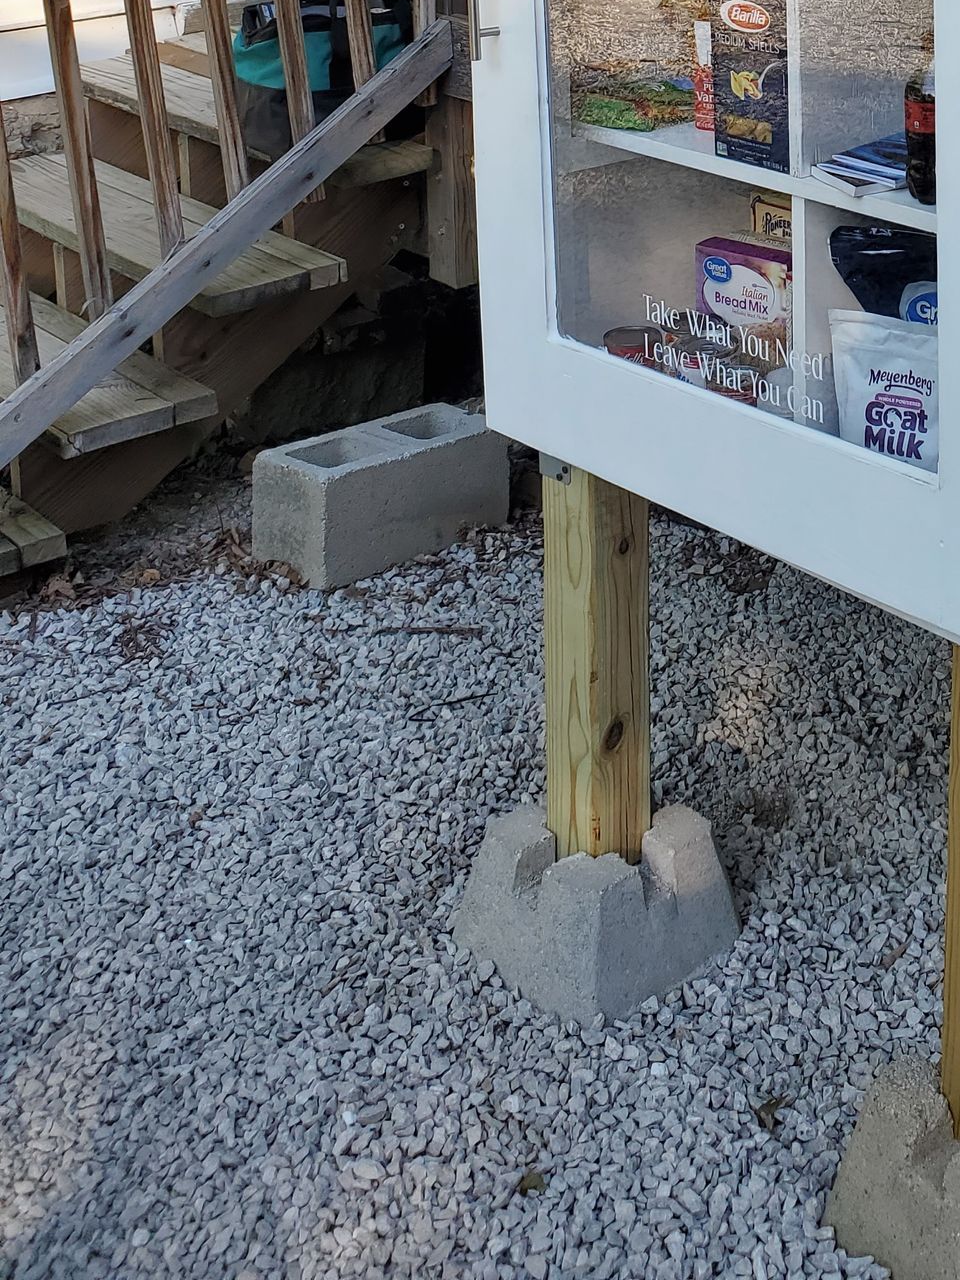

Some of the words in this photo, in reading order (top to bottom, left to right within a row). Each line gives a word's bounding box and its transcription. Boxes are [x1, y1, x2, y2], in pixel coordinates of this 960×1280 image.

[731, 7, 767, 26] Barilla
[714, 32, 745, 49] MEDIUM
[749, 39, 780, 54] SHELLS
[706, 261, 727, 274] Great
[715, 291, 746, 310] Bread
[749, 300, 769, 315] Mix
[741, 285, 768, 301] Italian
[642, 293, 680, 330] Take
[686, 308, 734, 349] What
[739, 326, 770, 361] You
[775, 338, 824, 381] Need
[643, 332, 691, 373] Leave
[696, 351, 745, 393] What
[750, 371, 780, 407] You
[787, 385, 824, 423] Can
[868, 368, 933, 397] Meyenberg
[865, 400, 928, 434] Goat
[864, 425, 925, 460] Milk
